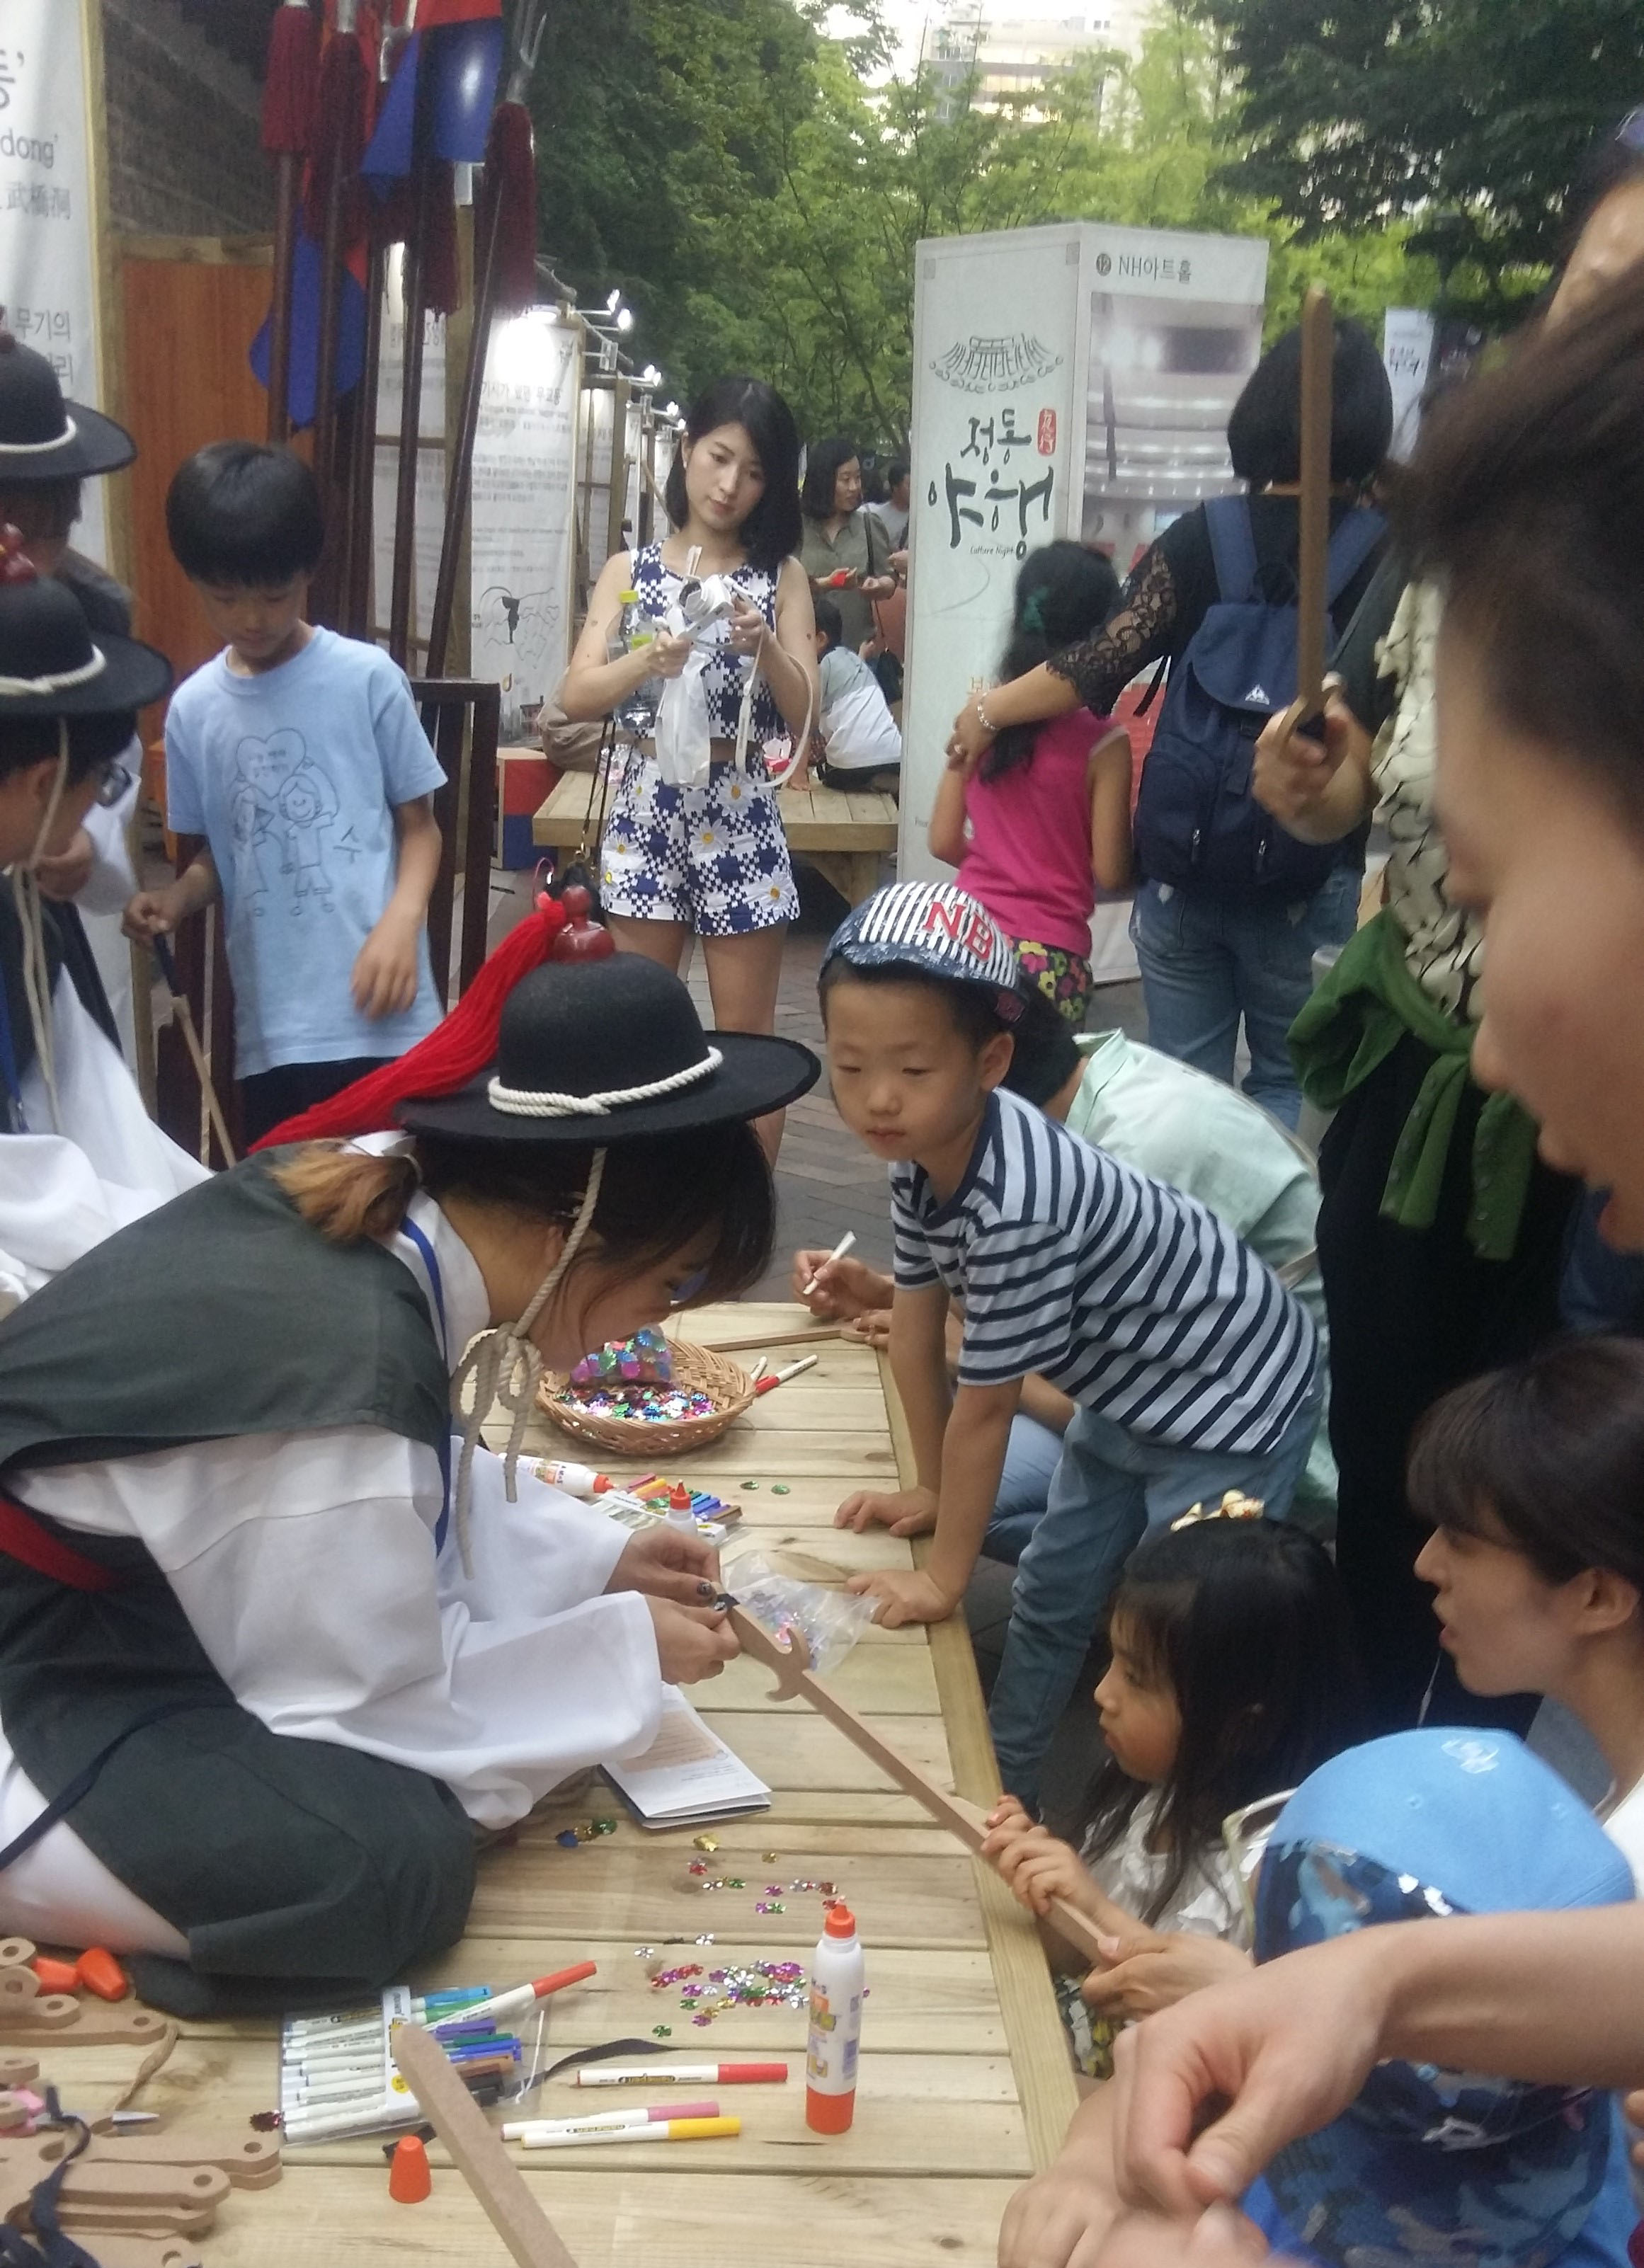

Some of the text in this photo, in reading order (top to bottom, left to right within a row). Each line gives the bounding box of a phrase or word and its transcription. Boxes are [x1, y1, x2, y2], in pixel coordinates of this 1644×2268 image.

[1119, 256, 1192, 284] NH아트홀
[15, 307, 71, 343] 무기의
[960, 408, 1032, 466] 정동
[927, 462, 1054, 561] 야행
[923, 901, 993, 961] NB
